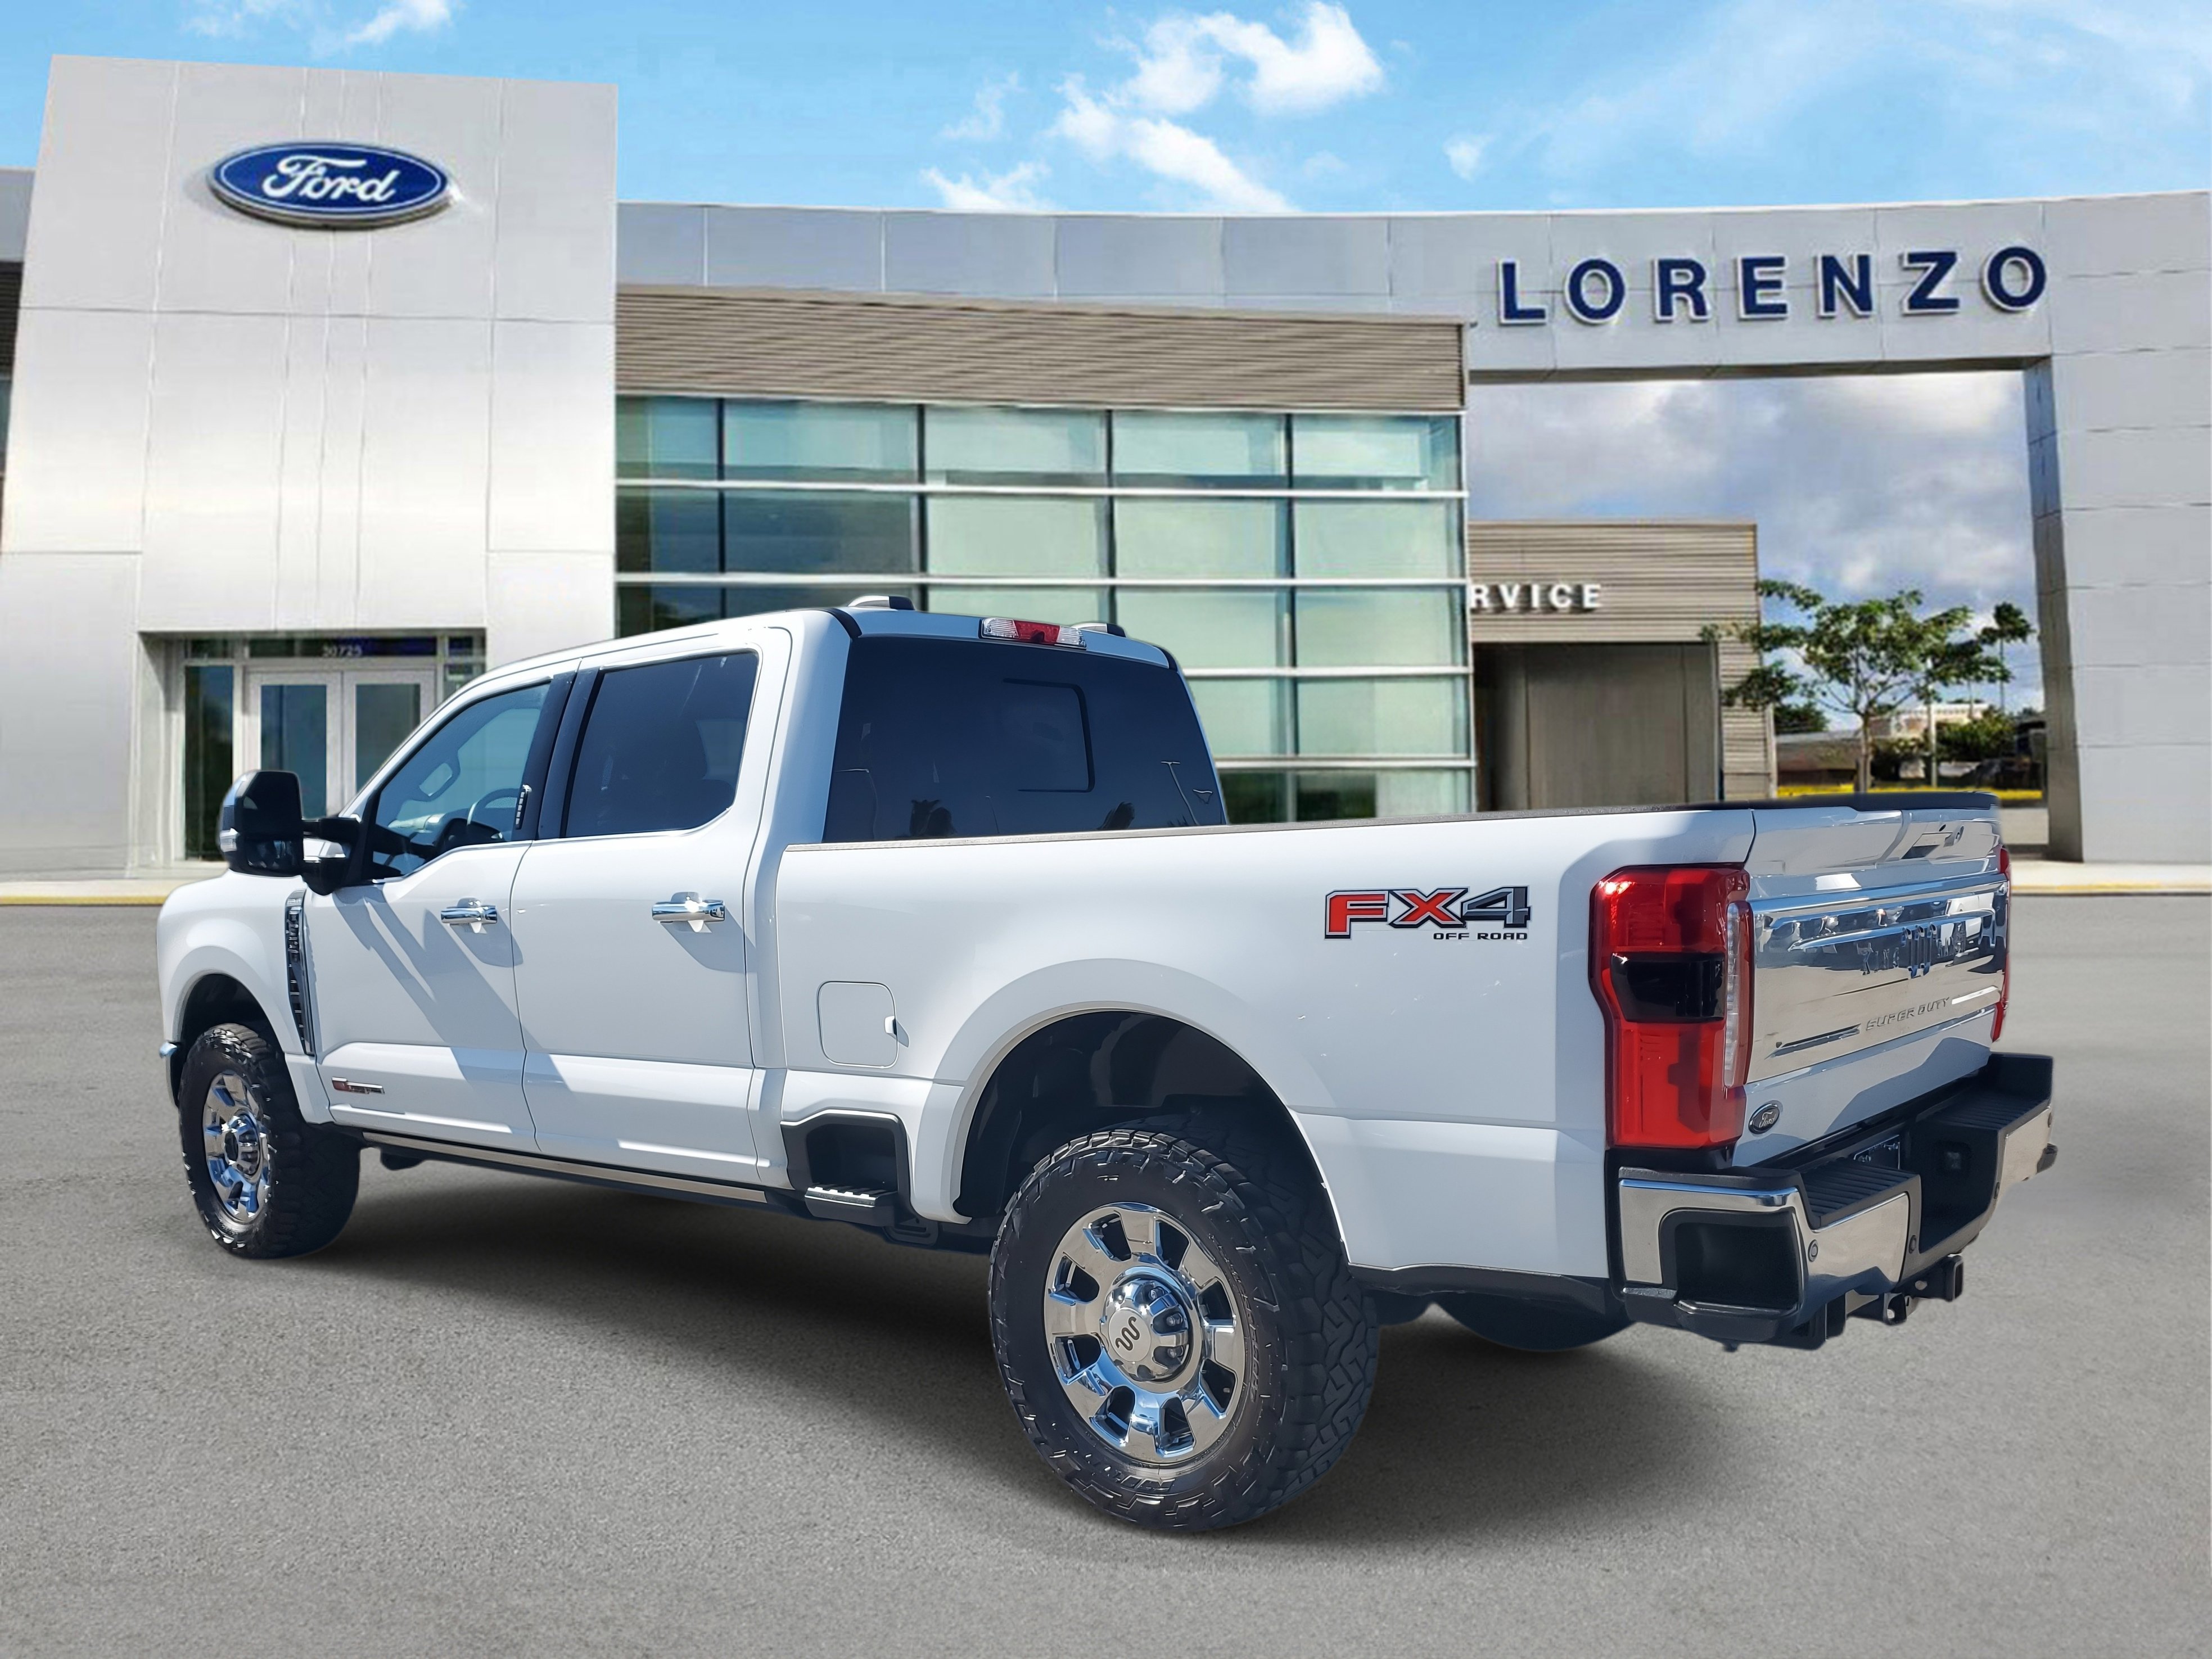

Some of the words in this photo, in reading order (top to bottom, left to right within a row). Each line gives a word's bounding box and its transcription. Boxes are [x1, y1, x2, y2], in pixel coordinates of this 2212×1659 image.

[262, 154, 400, 202] Ford
[1498, 246, 2048, 326] LORENZO
[1325, 885, 1532, 939] FX4
[1477, 932, 1528, 941] ROAD
[1866, 1007, 1915, 1030] SUPER
[1918, 997, 1950, 1015] DUTY
[1758, 1111, 1777, 1128] Ford
